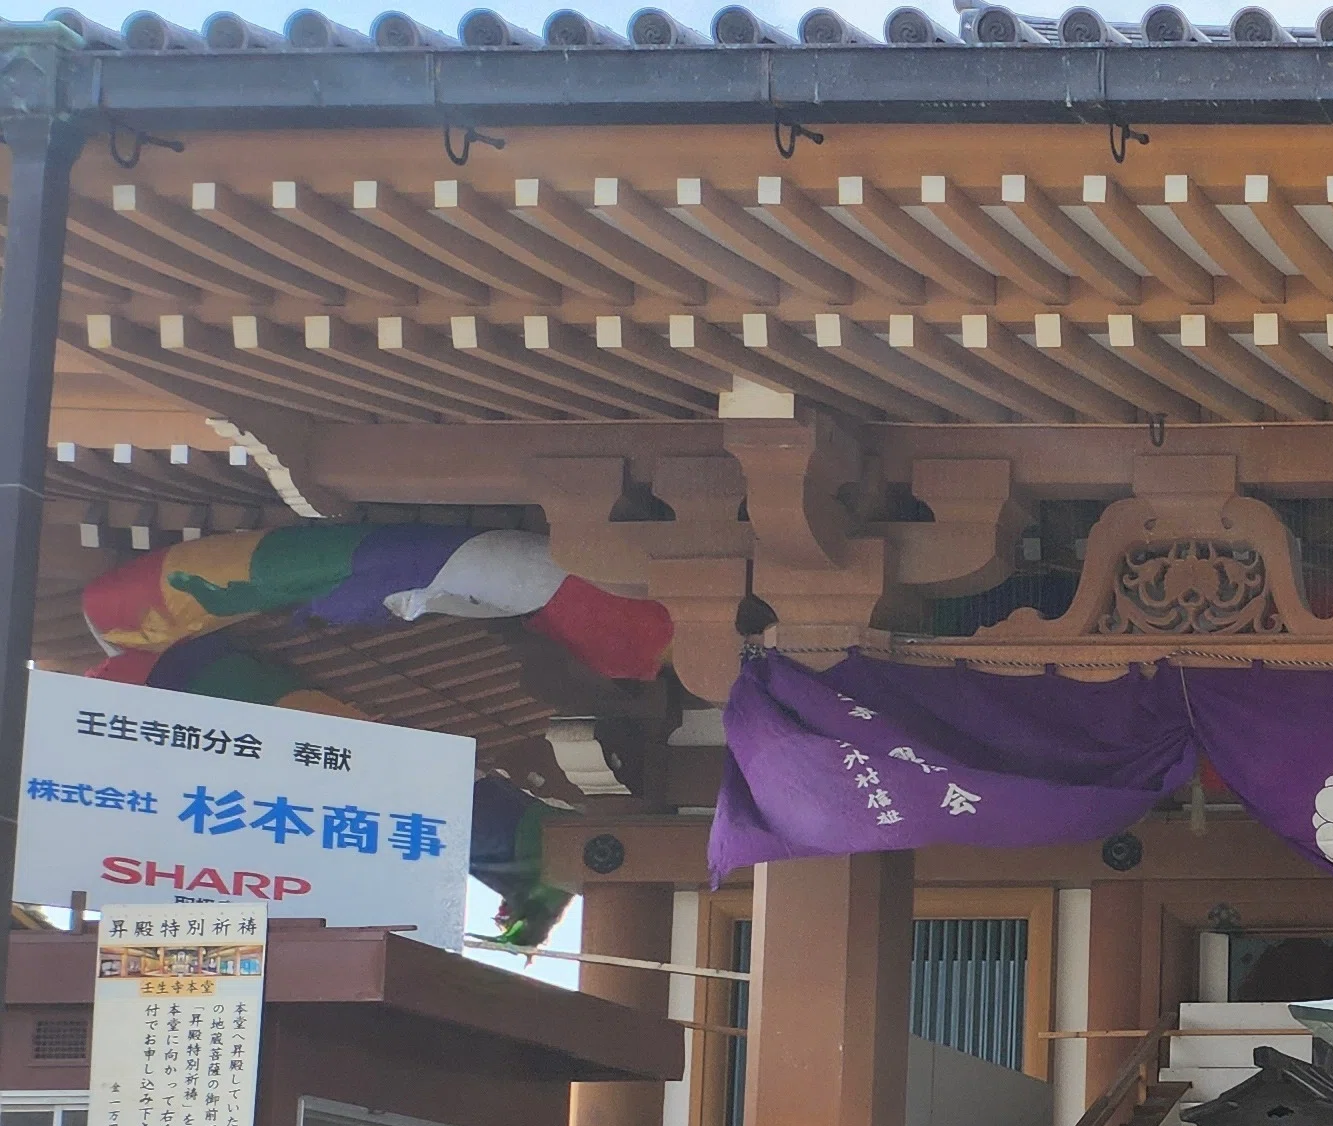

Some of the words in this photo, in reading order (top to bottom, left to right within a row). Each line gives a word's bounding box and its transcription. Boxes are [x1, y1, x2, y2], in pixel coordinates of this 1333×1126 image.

[77, 710, 262, 759] 壬生寺節分会
[293, 741, 351, 772] 奉献
[27, 778, 158, 815] 株式会社
[178, 785, 447, 861] 杉本商事
[101, 856, 312, 901] SHARP
[108, 917, 257, 938] 昇殿特別祈祷
[141, 979, 215, 994] 壬生寺本堂
